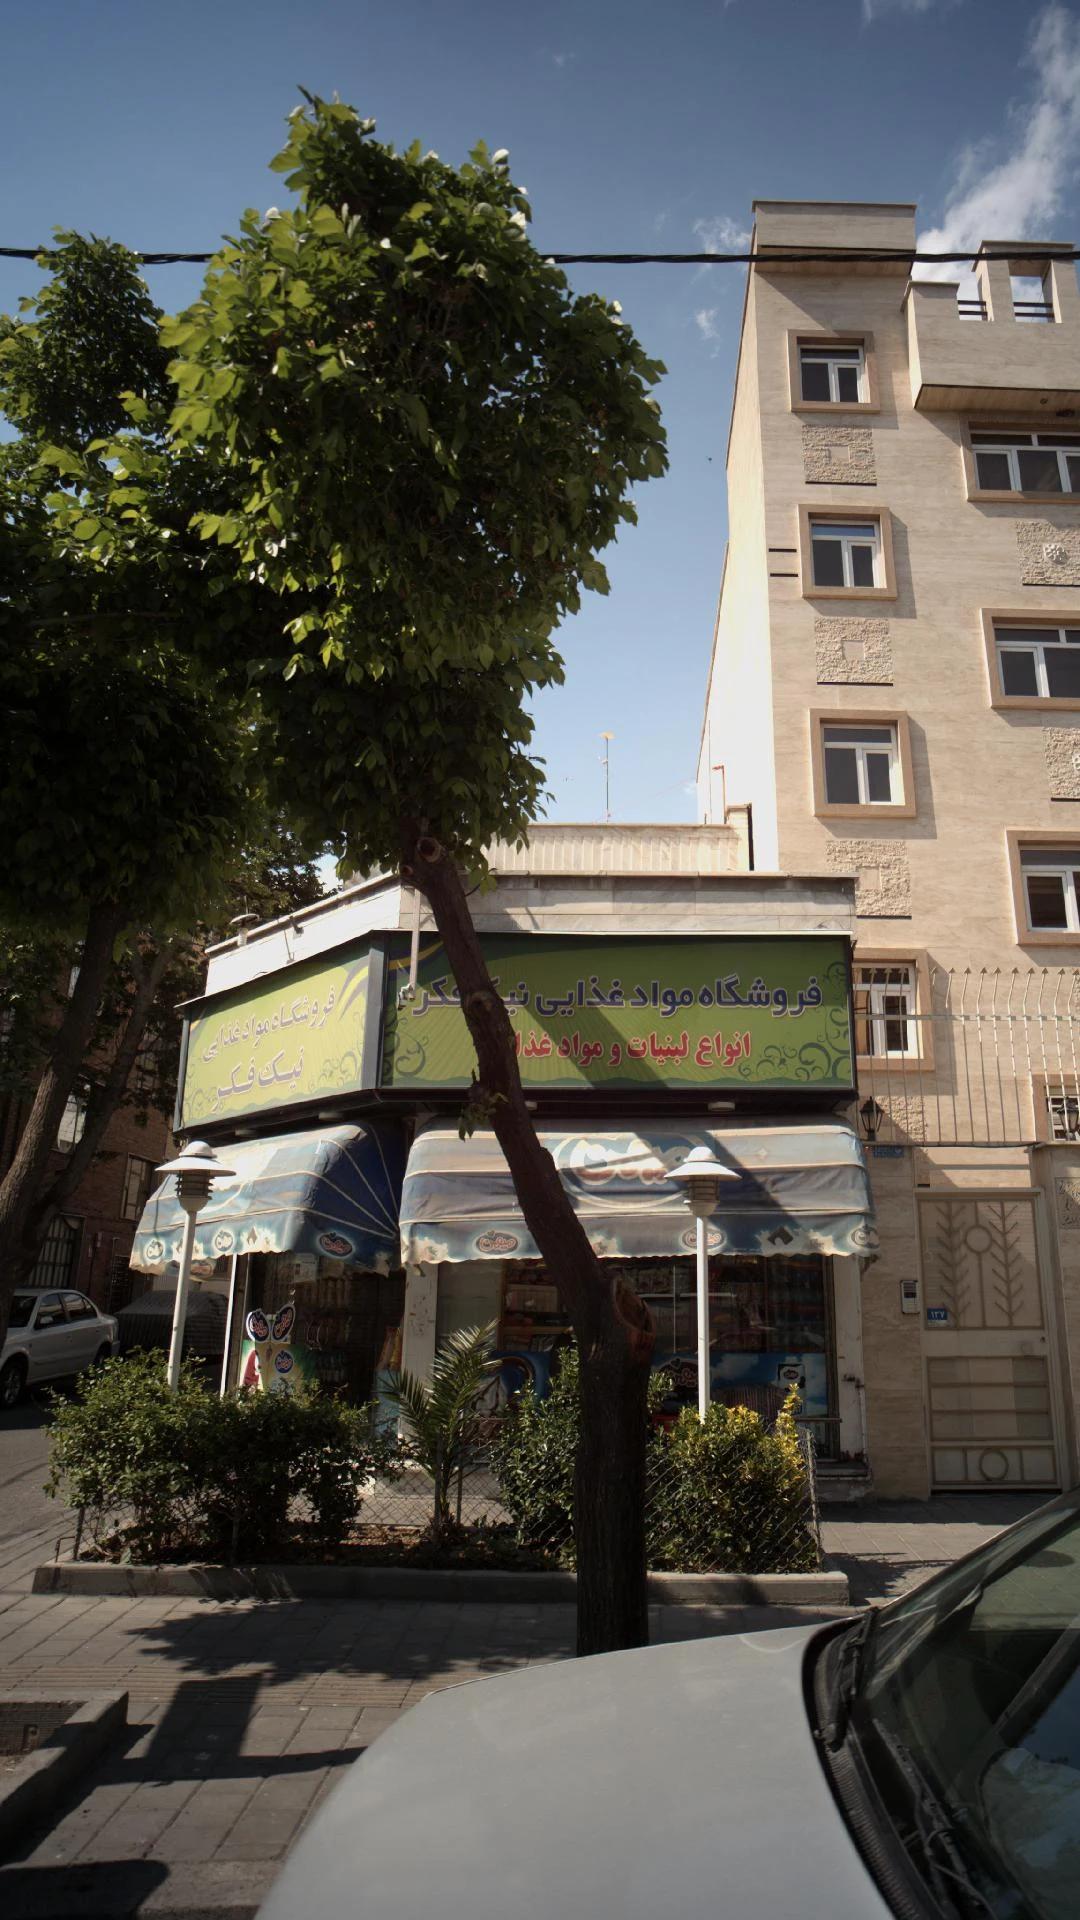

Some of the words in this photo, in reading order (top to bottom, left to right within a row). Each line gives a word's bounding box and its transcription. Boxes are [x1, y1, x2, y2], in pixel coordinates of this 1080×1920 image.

[270, 984, 336, 1030] فروشگاه
[535, 976, 625, 1017] غذایی
[629, 980, 694, 1018] مواد
[697, 974, 823, 1018] فروشگاه
[202, 1020, 241, 1063] غذایی
[242, 1013, 270, 1049] مواد
[514, 1030, 553, 1058] غذا
[556, 1030, 605, 1068] مواد
[626, 1030, 689, 1066] لبنیات
[695, 1031, 751, 1068] انواع
[257, 1045, 304, 1093] نیک
[607, 1041, 622, 1068] و
[211, 1056, 256, 1114] فکر
